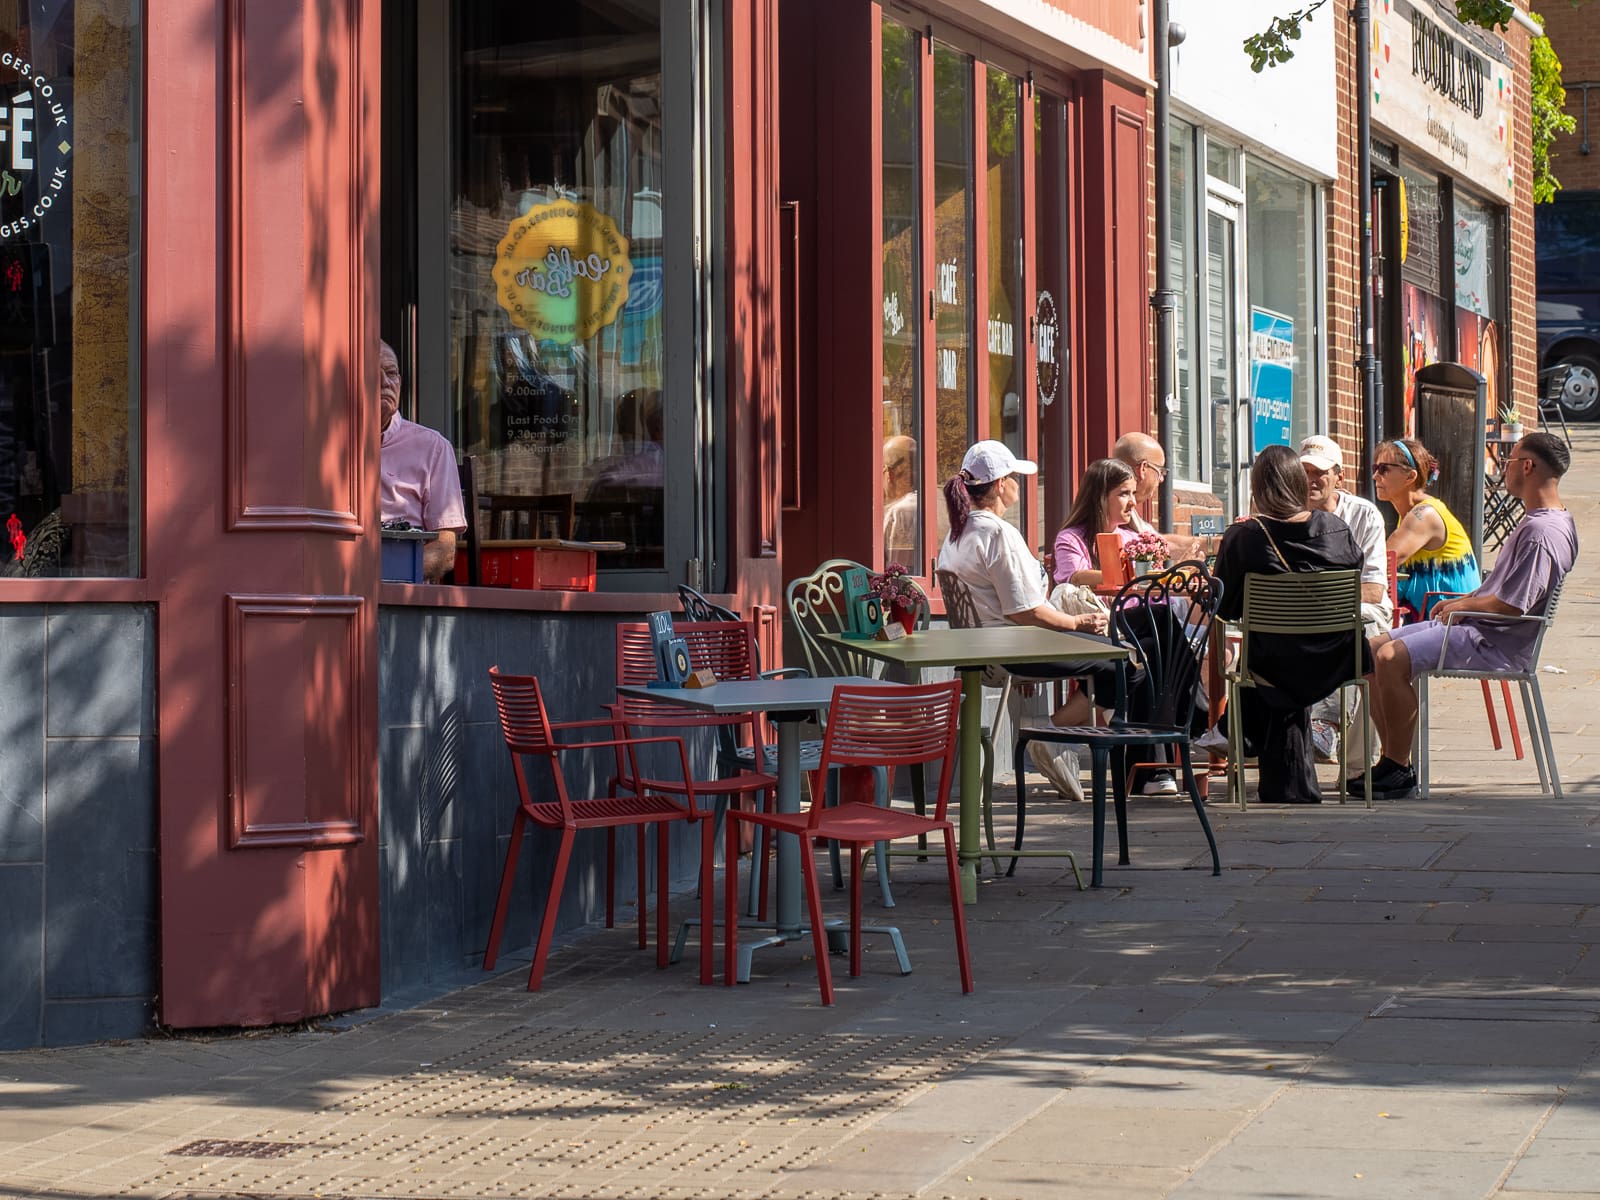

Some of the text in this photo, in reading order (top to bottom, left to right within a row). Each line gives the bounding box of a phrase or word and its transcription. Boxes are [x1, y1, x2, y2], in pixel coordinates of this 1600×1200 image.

[940, 257, 958, 306] CAFÉ
[533, 414, 559, 425] Food
[1198, 519, 1215, 530] 101
